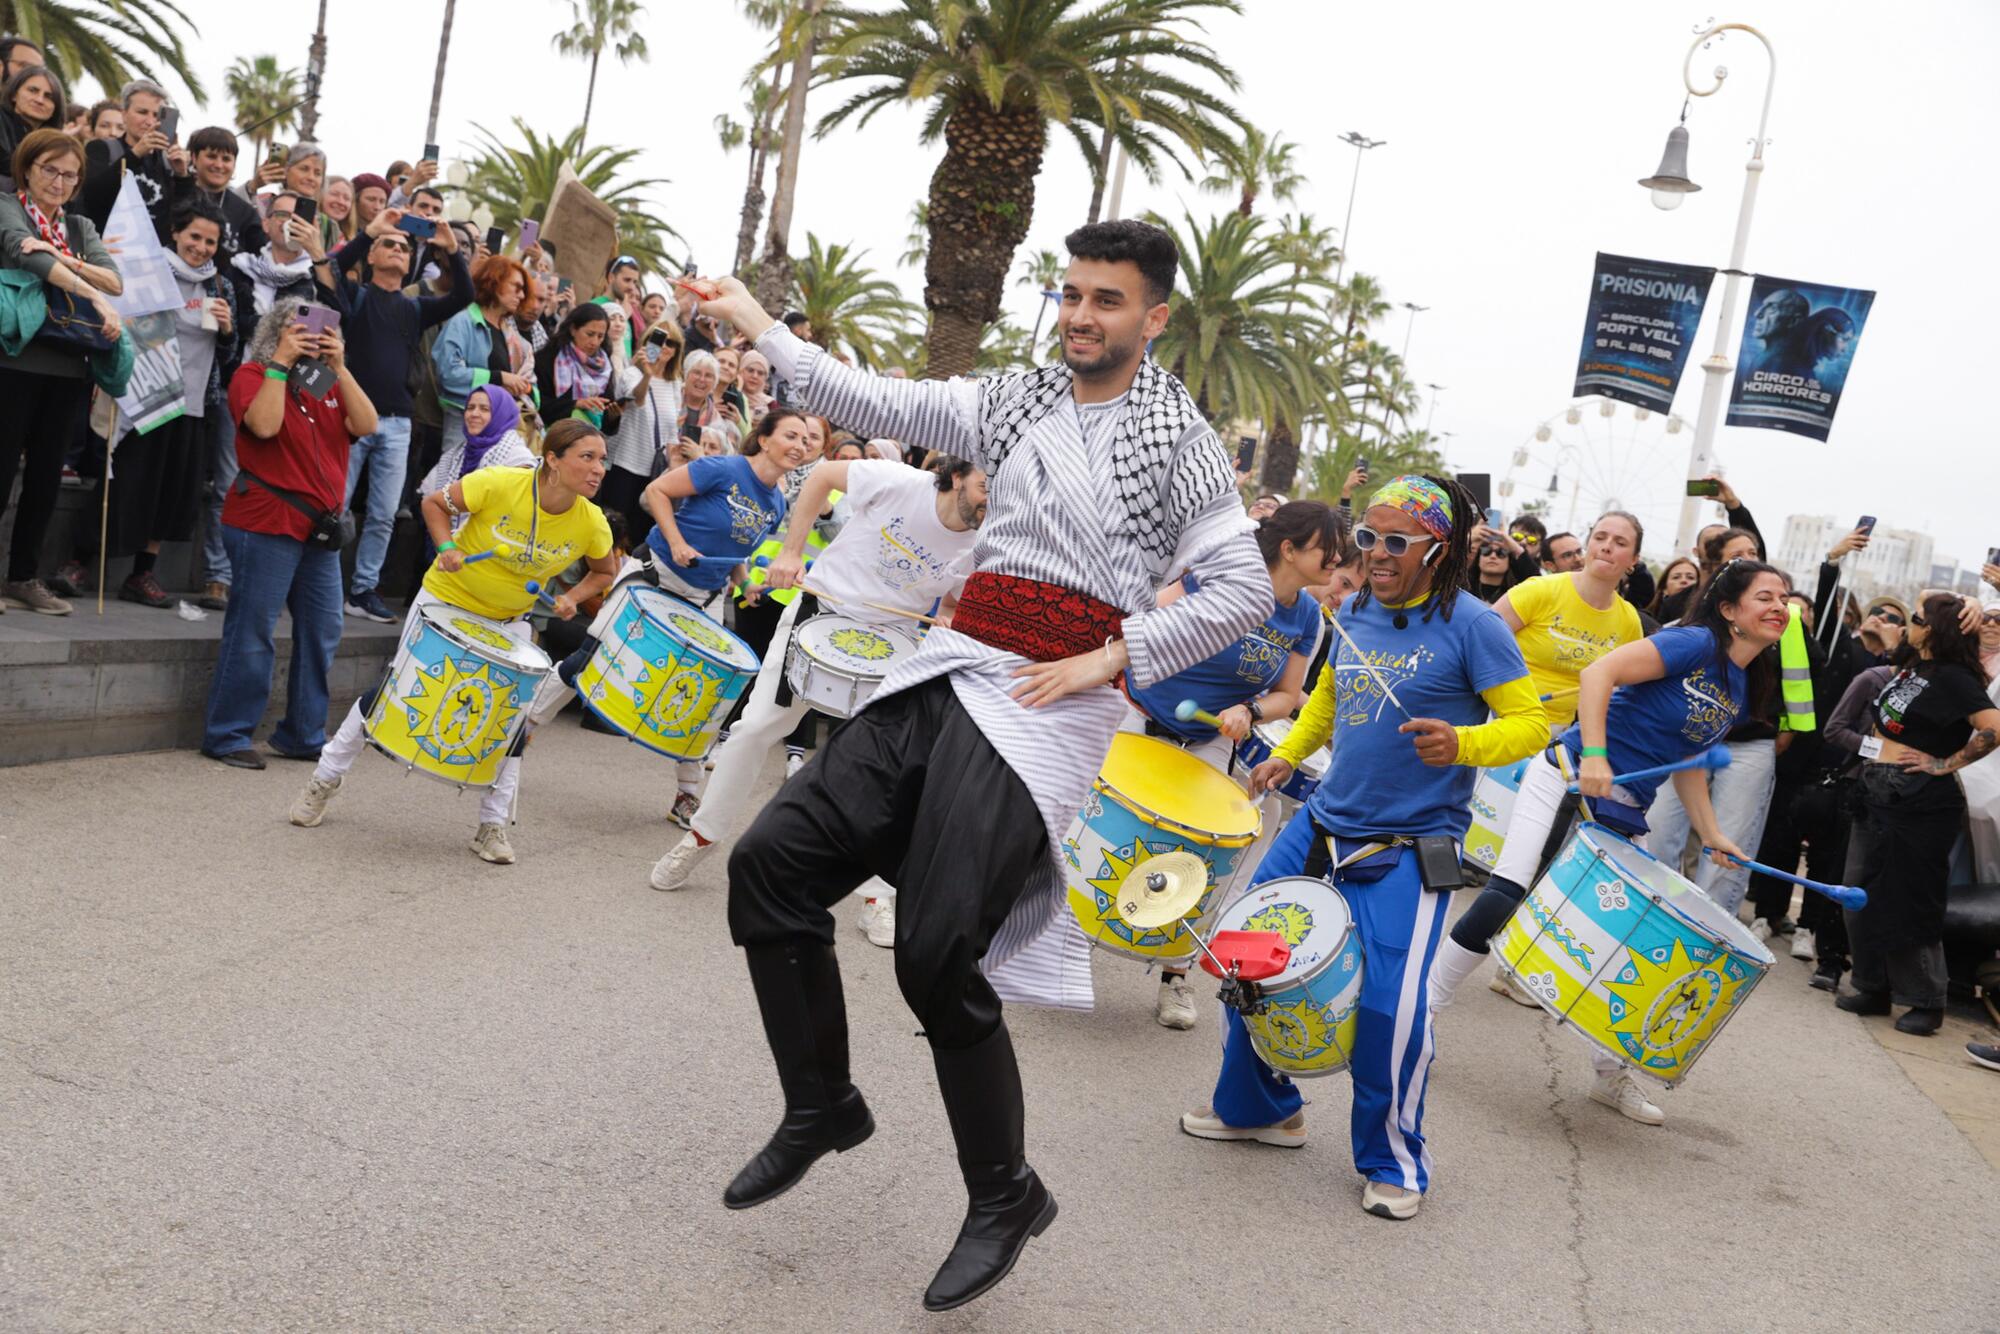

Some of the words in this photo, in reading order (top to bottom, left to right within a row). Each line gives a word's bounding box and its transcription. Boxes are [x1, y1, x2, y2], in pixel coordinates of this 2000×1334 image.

[1599, 273, 1699, 306] PRISIONIA
[1596, 321, 1638, 336] PORT
[1641, 327, 1681, 346] VELL
[1753, 371, 1805, 387] CIRCO
[1743, 381, 1832, 404] HORRORES
